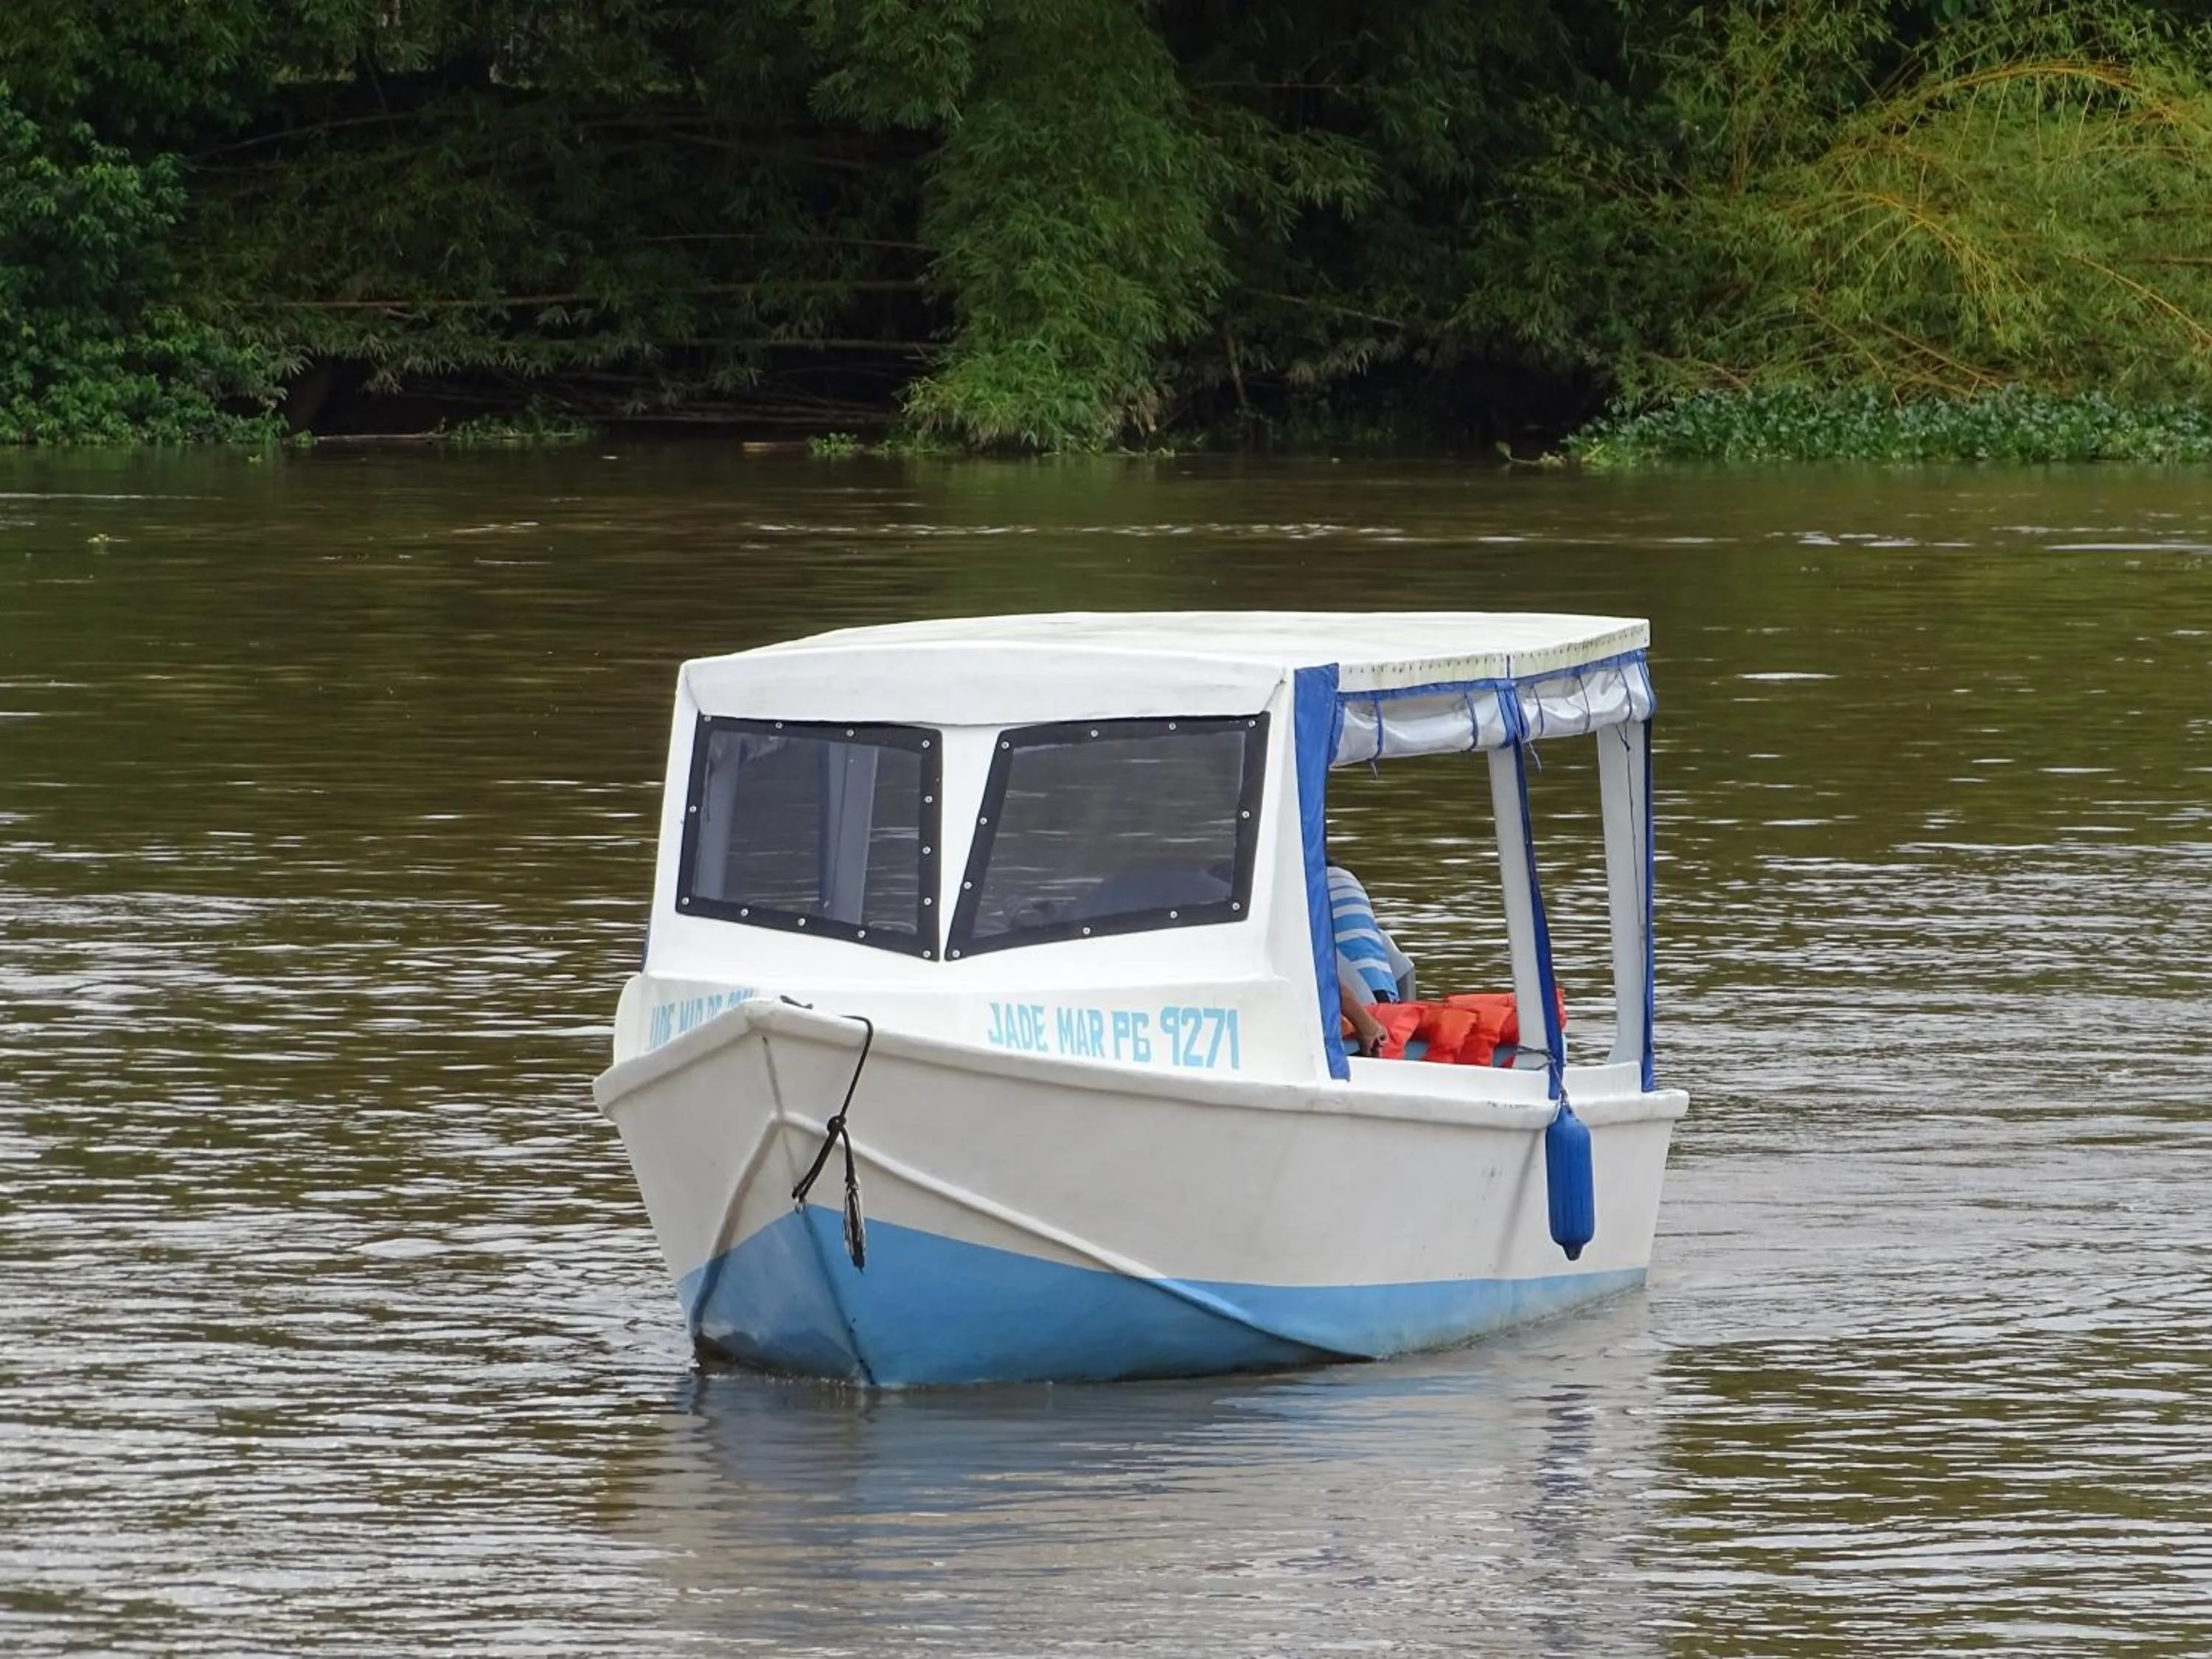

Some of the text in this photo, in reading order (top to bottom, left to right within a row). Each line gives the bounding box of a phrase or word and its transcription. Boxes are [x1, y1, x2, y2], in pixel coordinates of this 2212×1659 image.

[987, 1002, 1048, 1052] JADE
[1056, 1006, 1106, 1059] MAR
[1159, 1006, 1240, 1070] 9271
